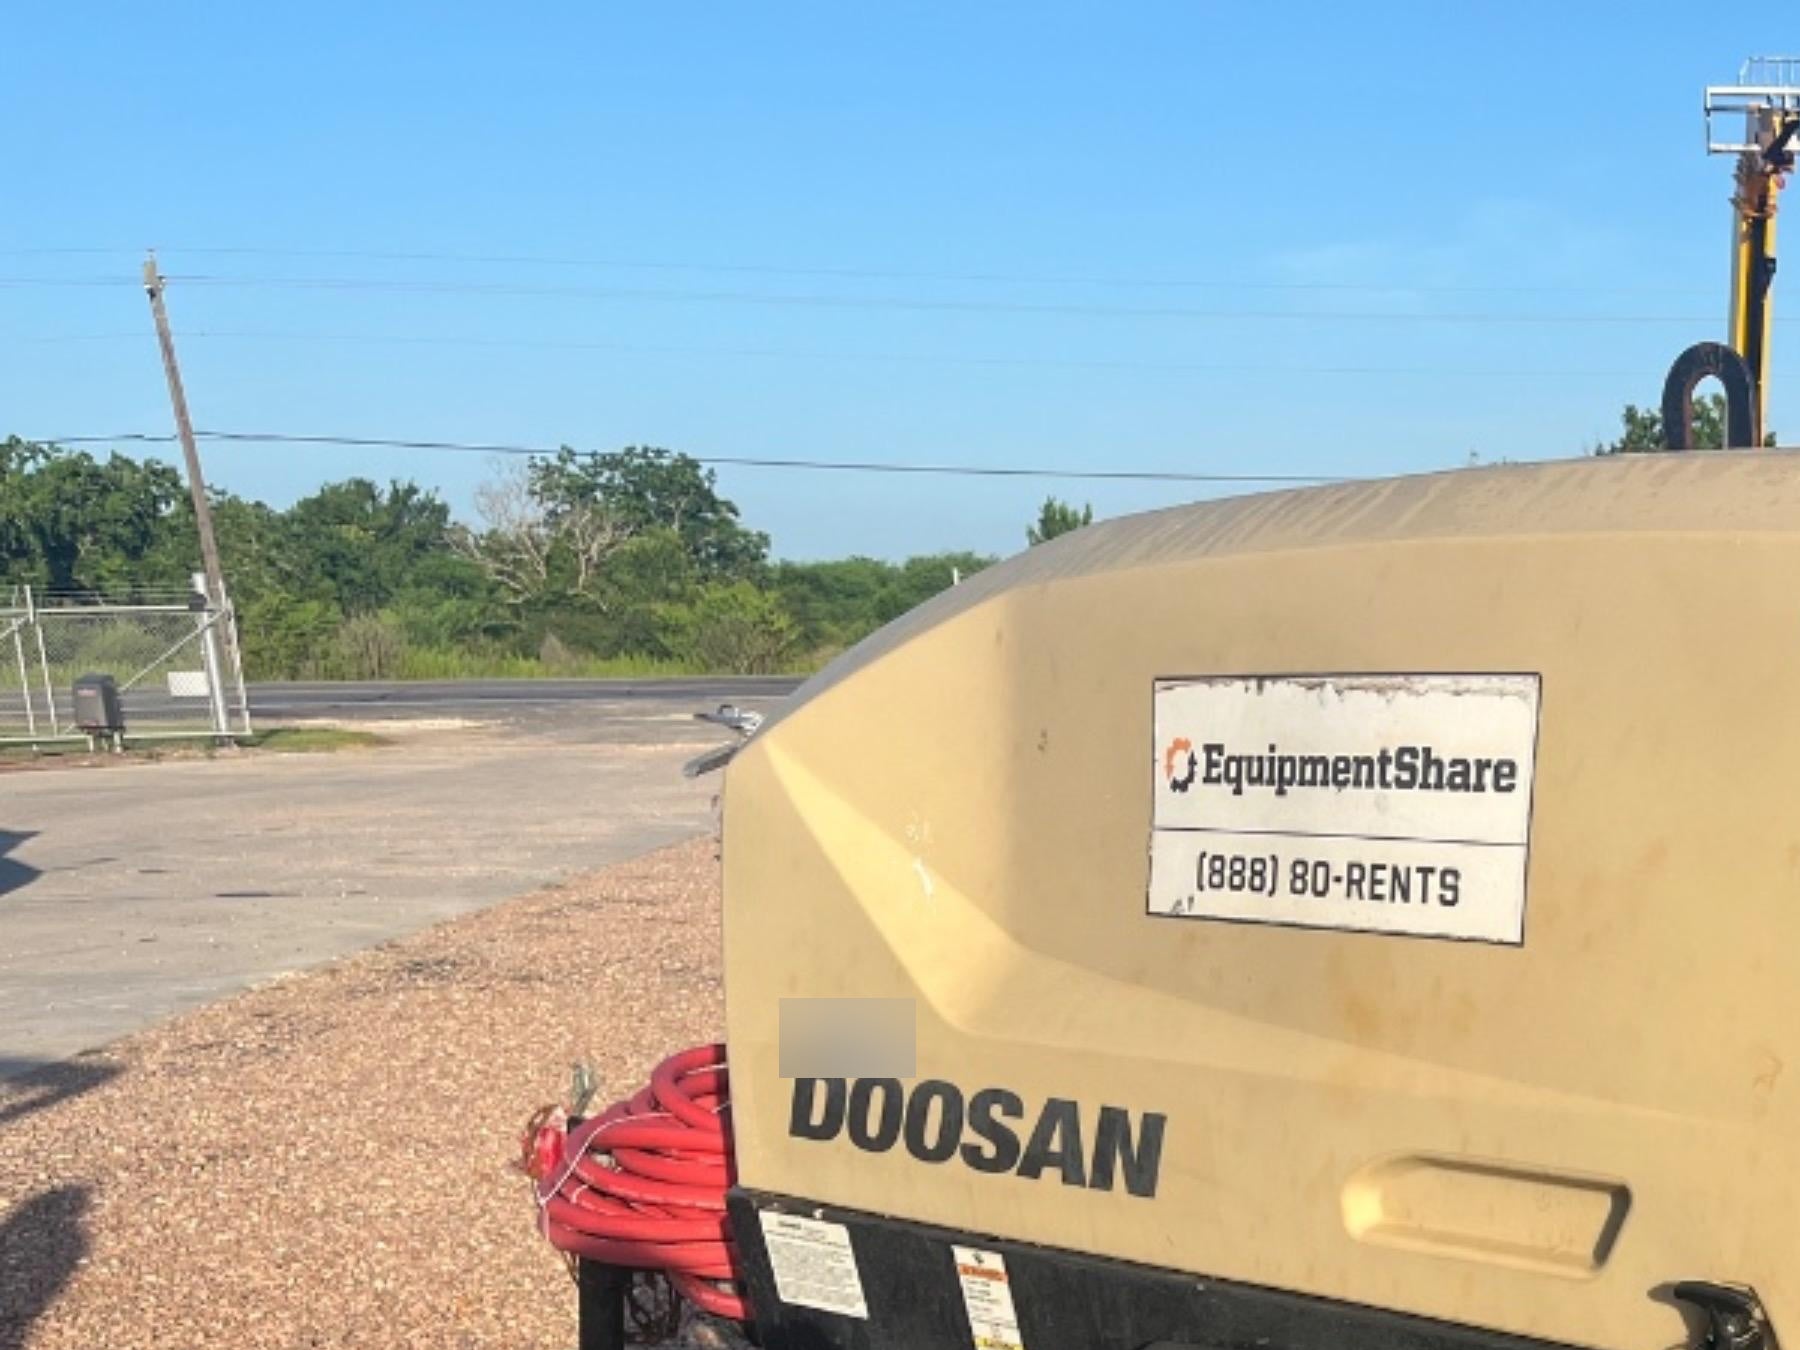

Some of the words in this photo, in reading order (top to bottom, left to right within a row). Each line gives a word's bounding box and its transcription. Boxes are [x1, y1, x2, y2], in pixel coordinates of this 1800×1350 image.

[1202, 744, 1518, 796] EquipmentShare
[1197, 851, 1278, 897] (888)
[1289, 860, 1462, 907] 80-RENTS
[789, 1076, 1167, 1199] DOOSAN
